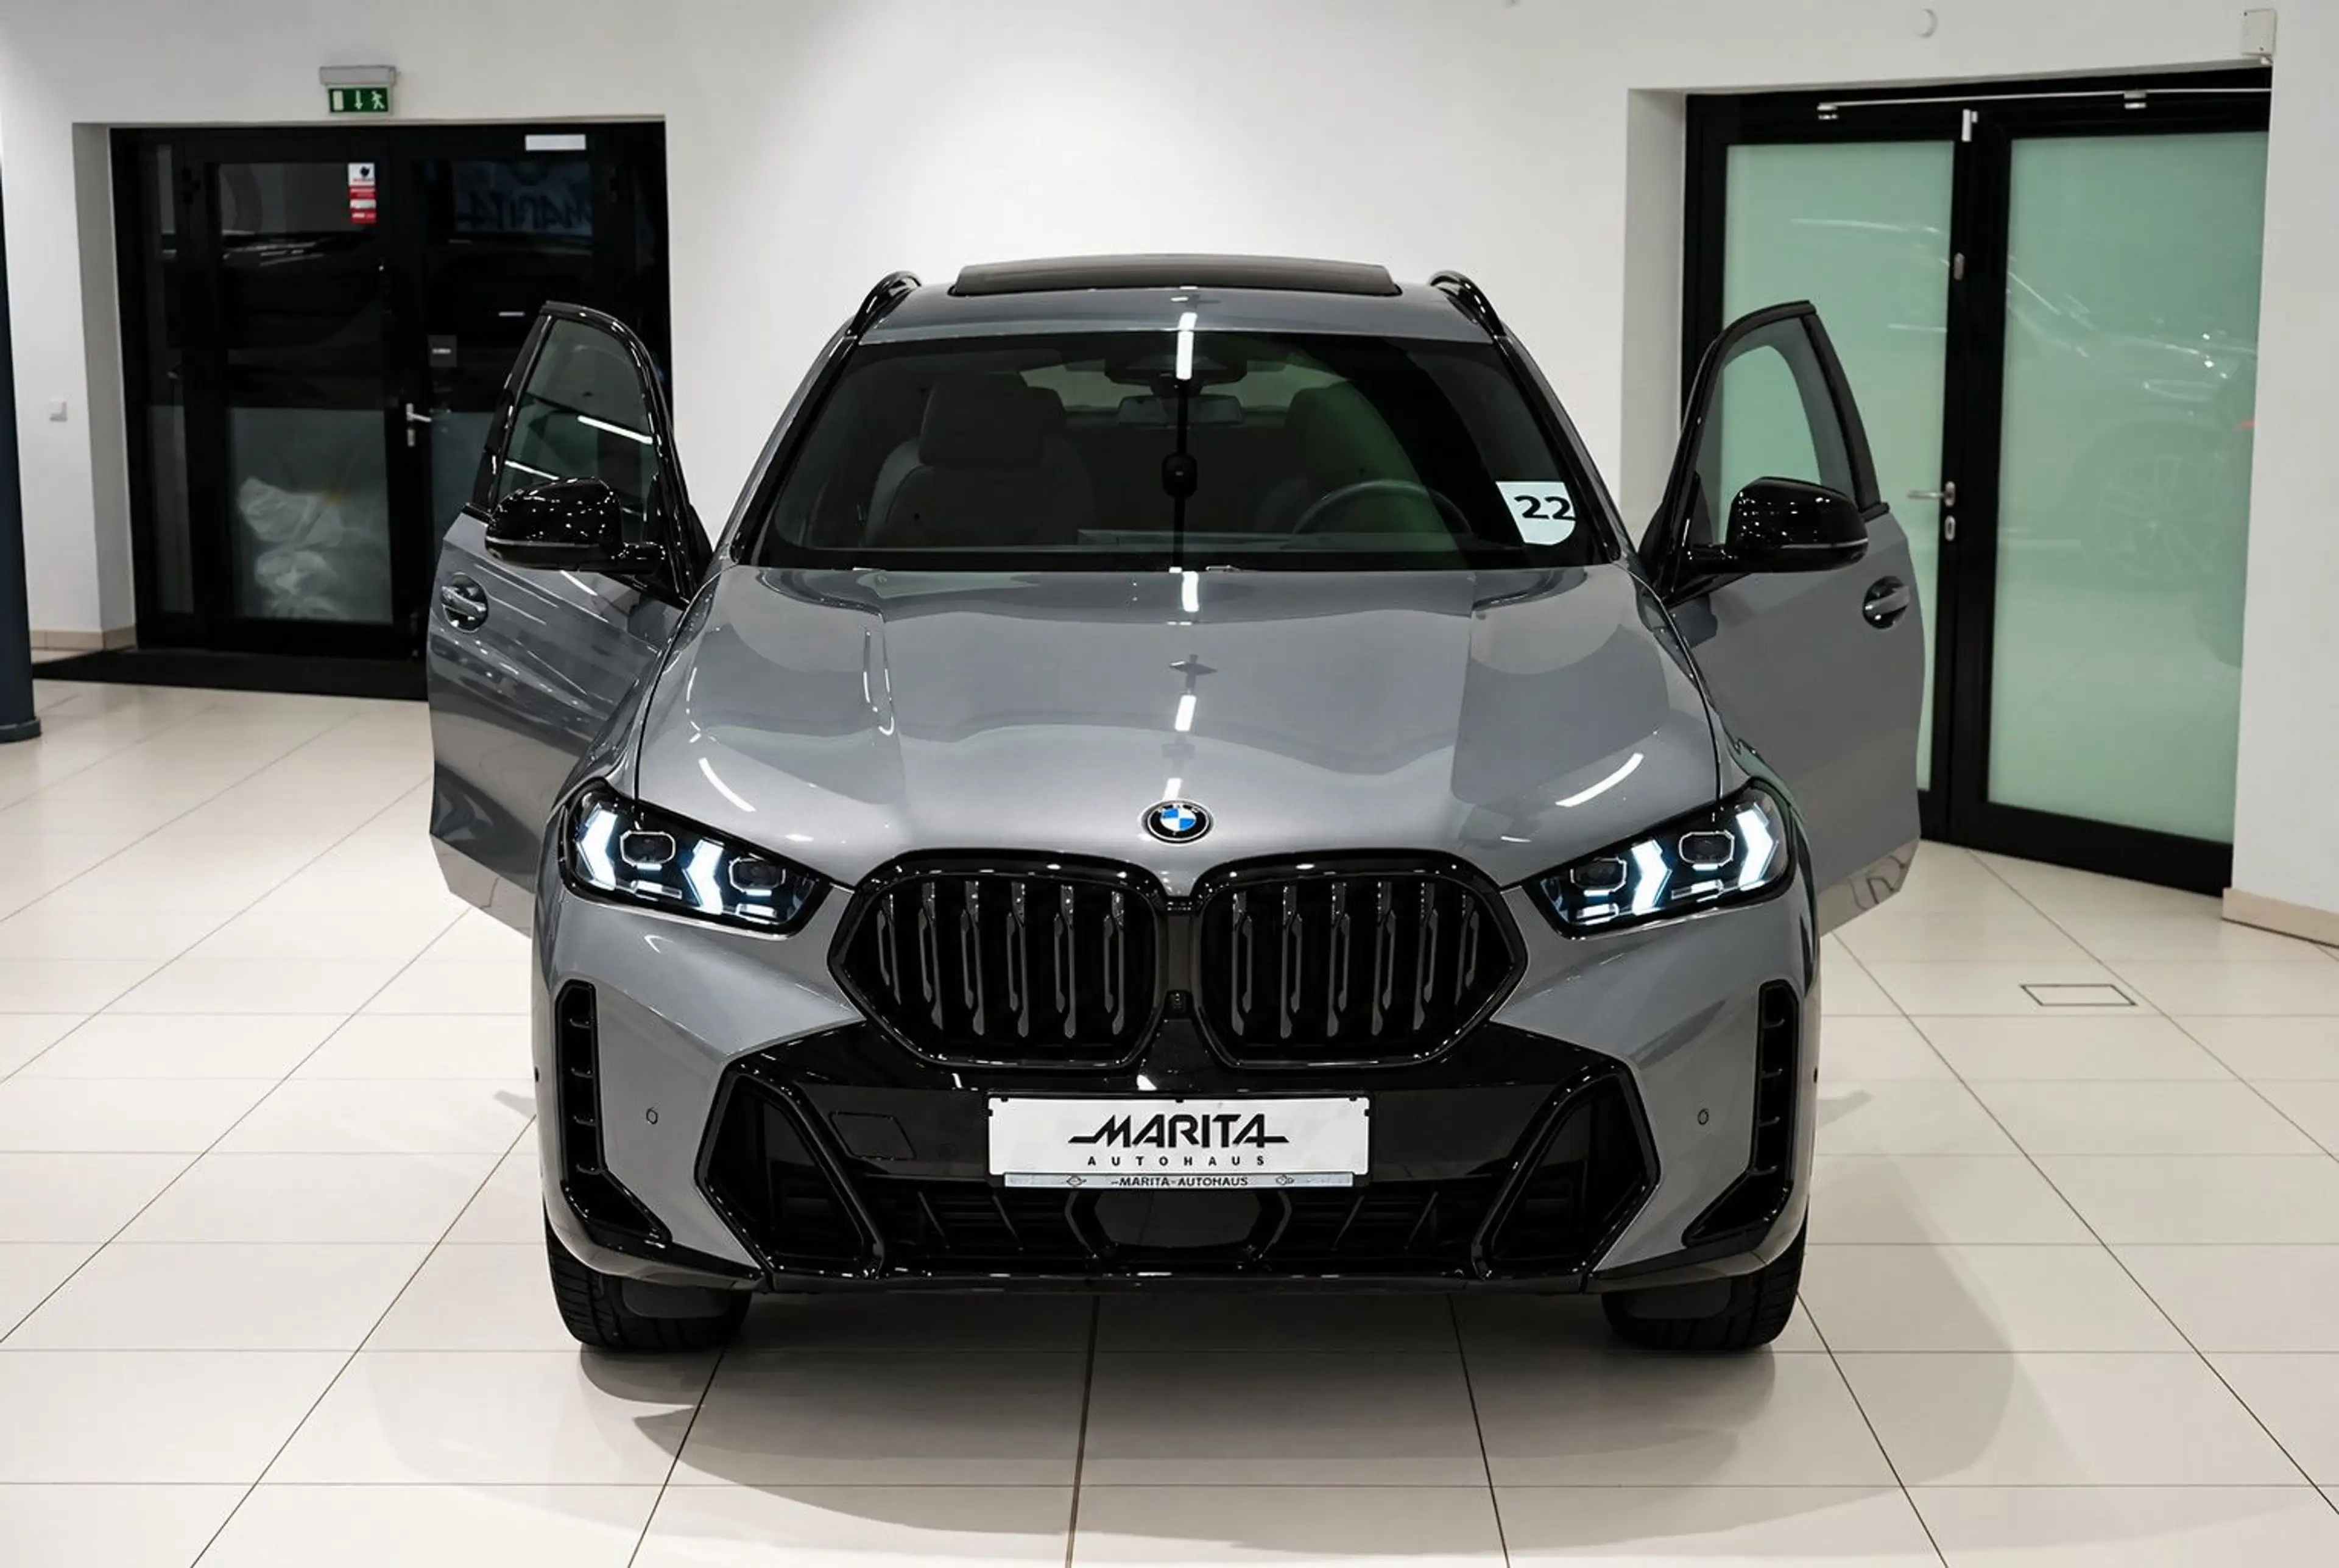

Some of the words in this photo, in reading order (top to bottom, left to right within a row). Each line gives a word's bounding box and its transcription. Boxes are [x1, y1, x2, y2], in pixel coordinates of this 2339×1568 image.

[1514, 494, 1576, 521] 22
[1068, 1114, 1289, 1148] MARITA
[1088, 1155, 1265, 1166] AUTOHAUS
